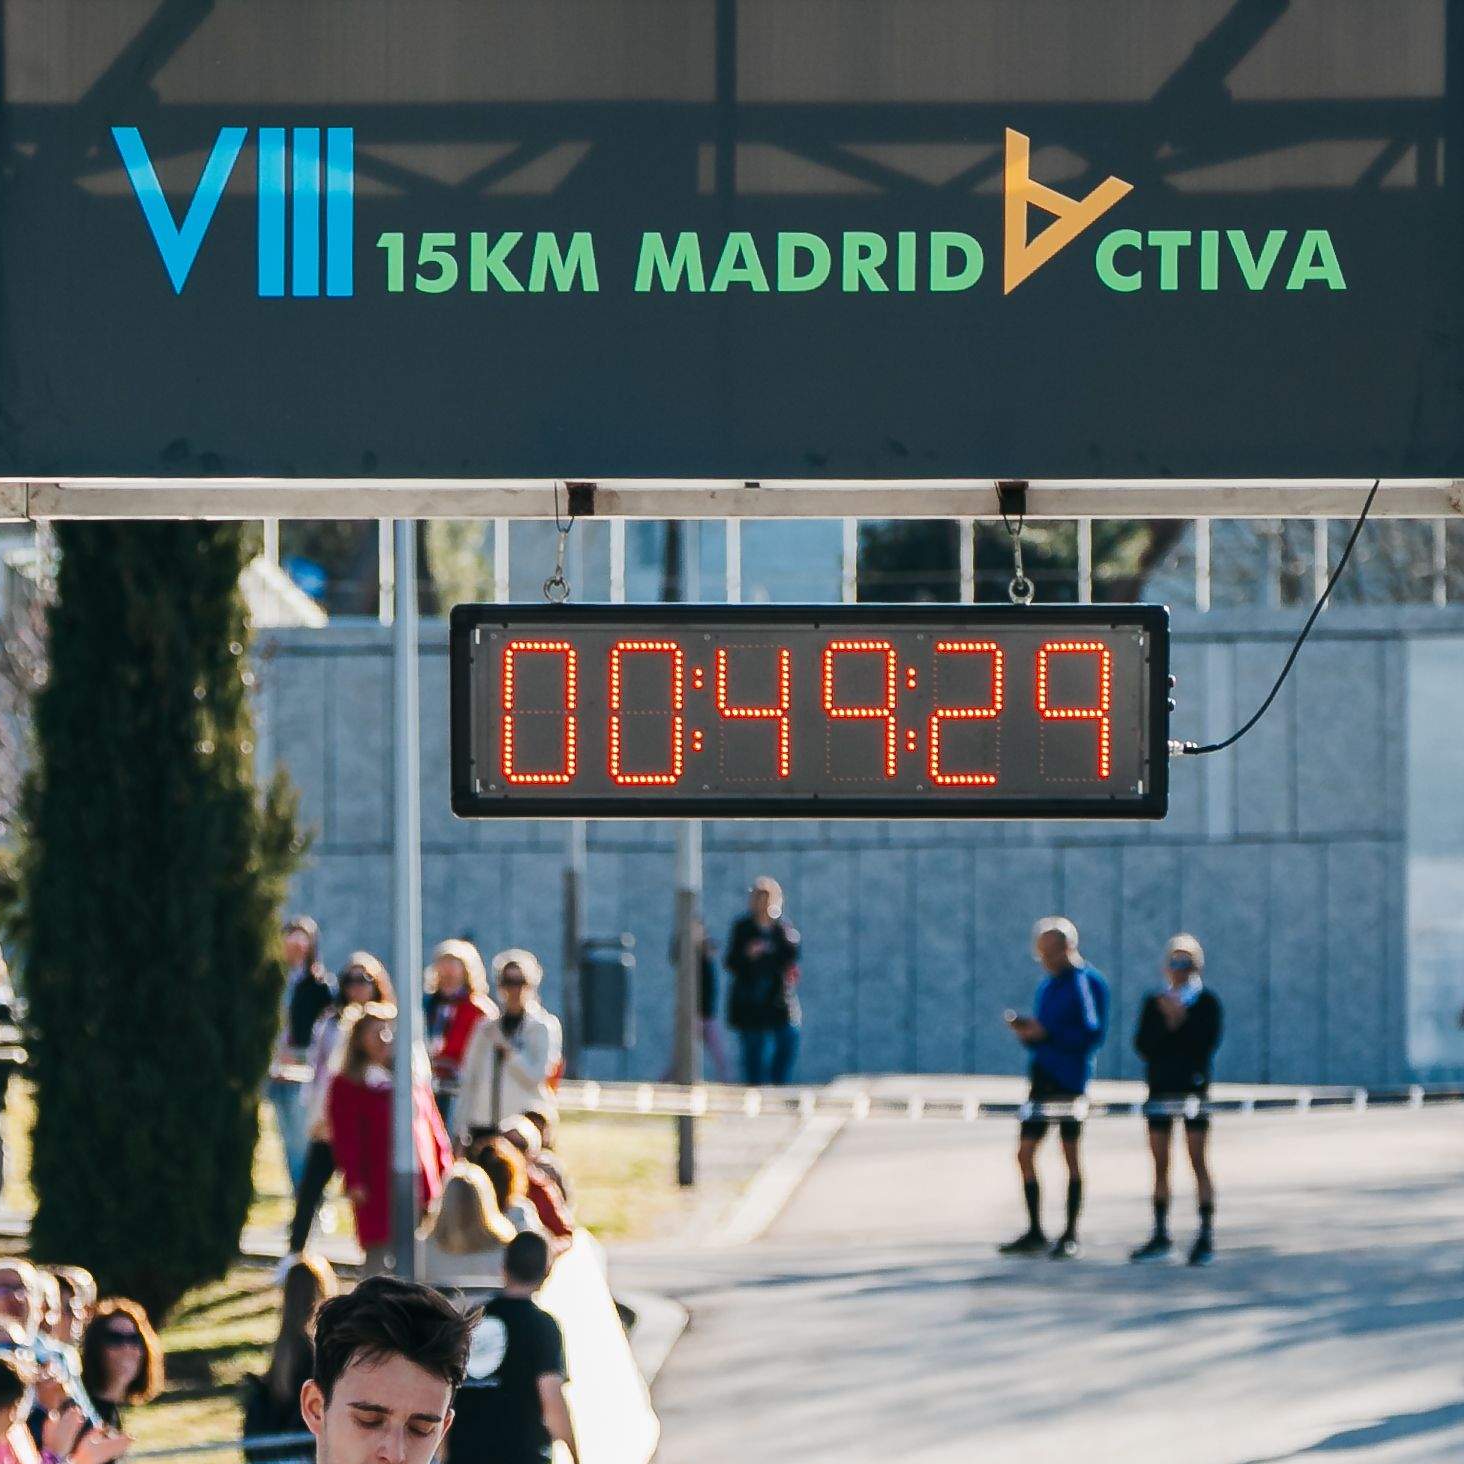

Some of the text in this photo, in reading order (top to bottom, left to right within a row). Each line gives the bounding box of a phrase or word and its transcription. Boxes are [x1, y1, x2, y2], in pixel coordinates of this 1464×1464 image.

[110, 126, 354, 298] VIII
[376, 231, 600, 295] 15KM
[634, 230, 985, 295] MADRID
[502, 640, 1112, 786] 00:49:29
